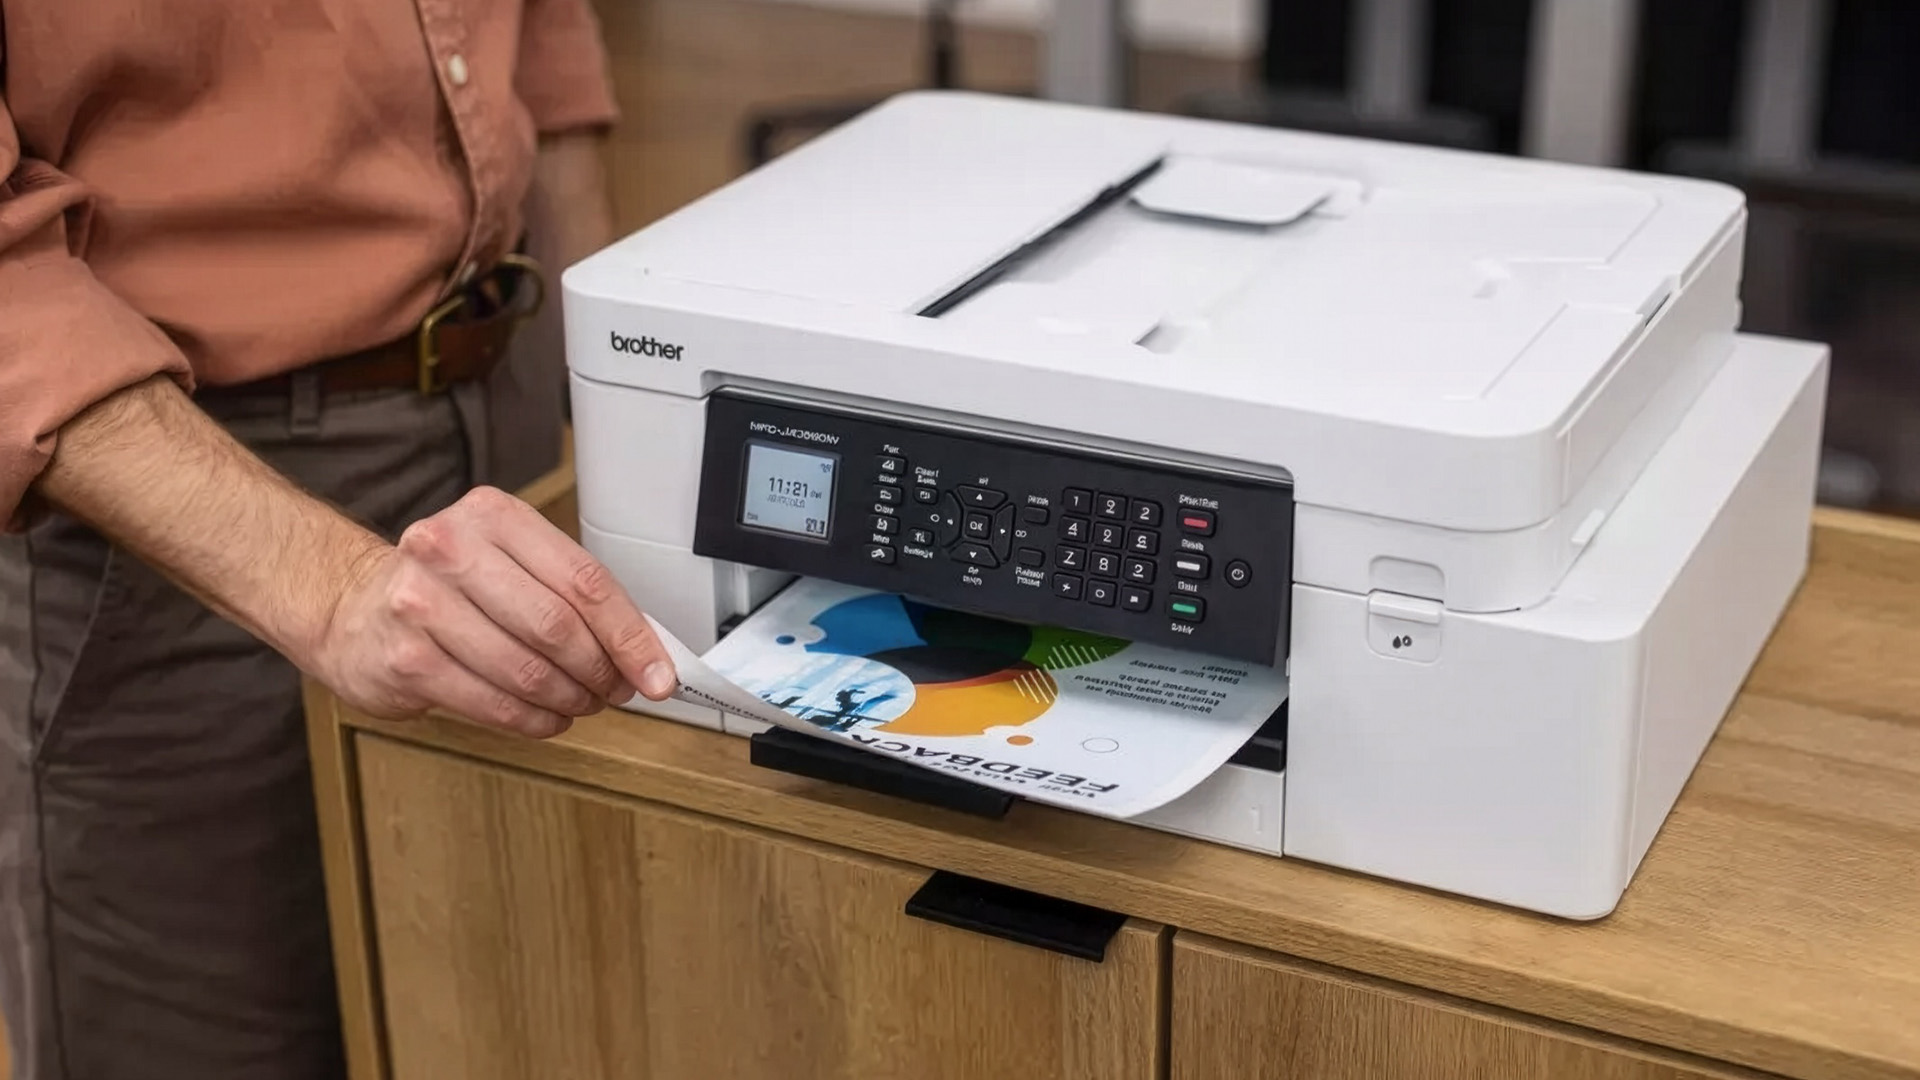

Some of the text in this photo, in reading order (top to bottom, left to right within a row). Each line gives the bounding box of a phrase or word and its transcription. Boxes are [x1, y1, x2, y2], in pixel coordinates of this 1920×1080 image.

[611, 331, 684, 361] brother
[1073, 495, 1079, 507] 1
[1099, 557, 1109, 571] 8
